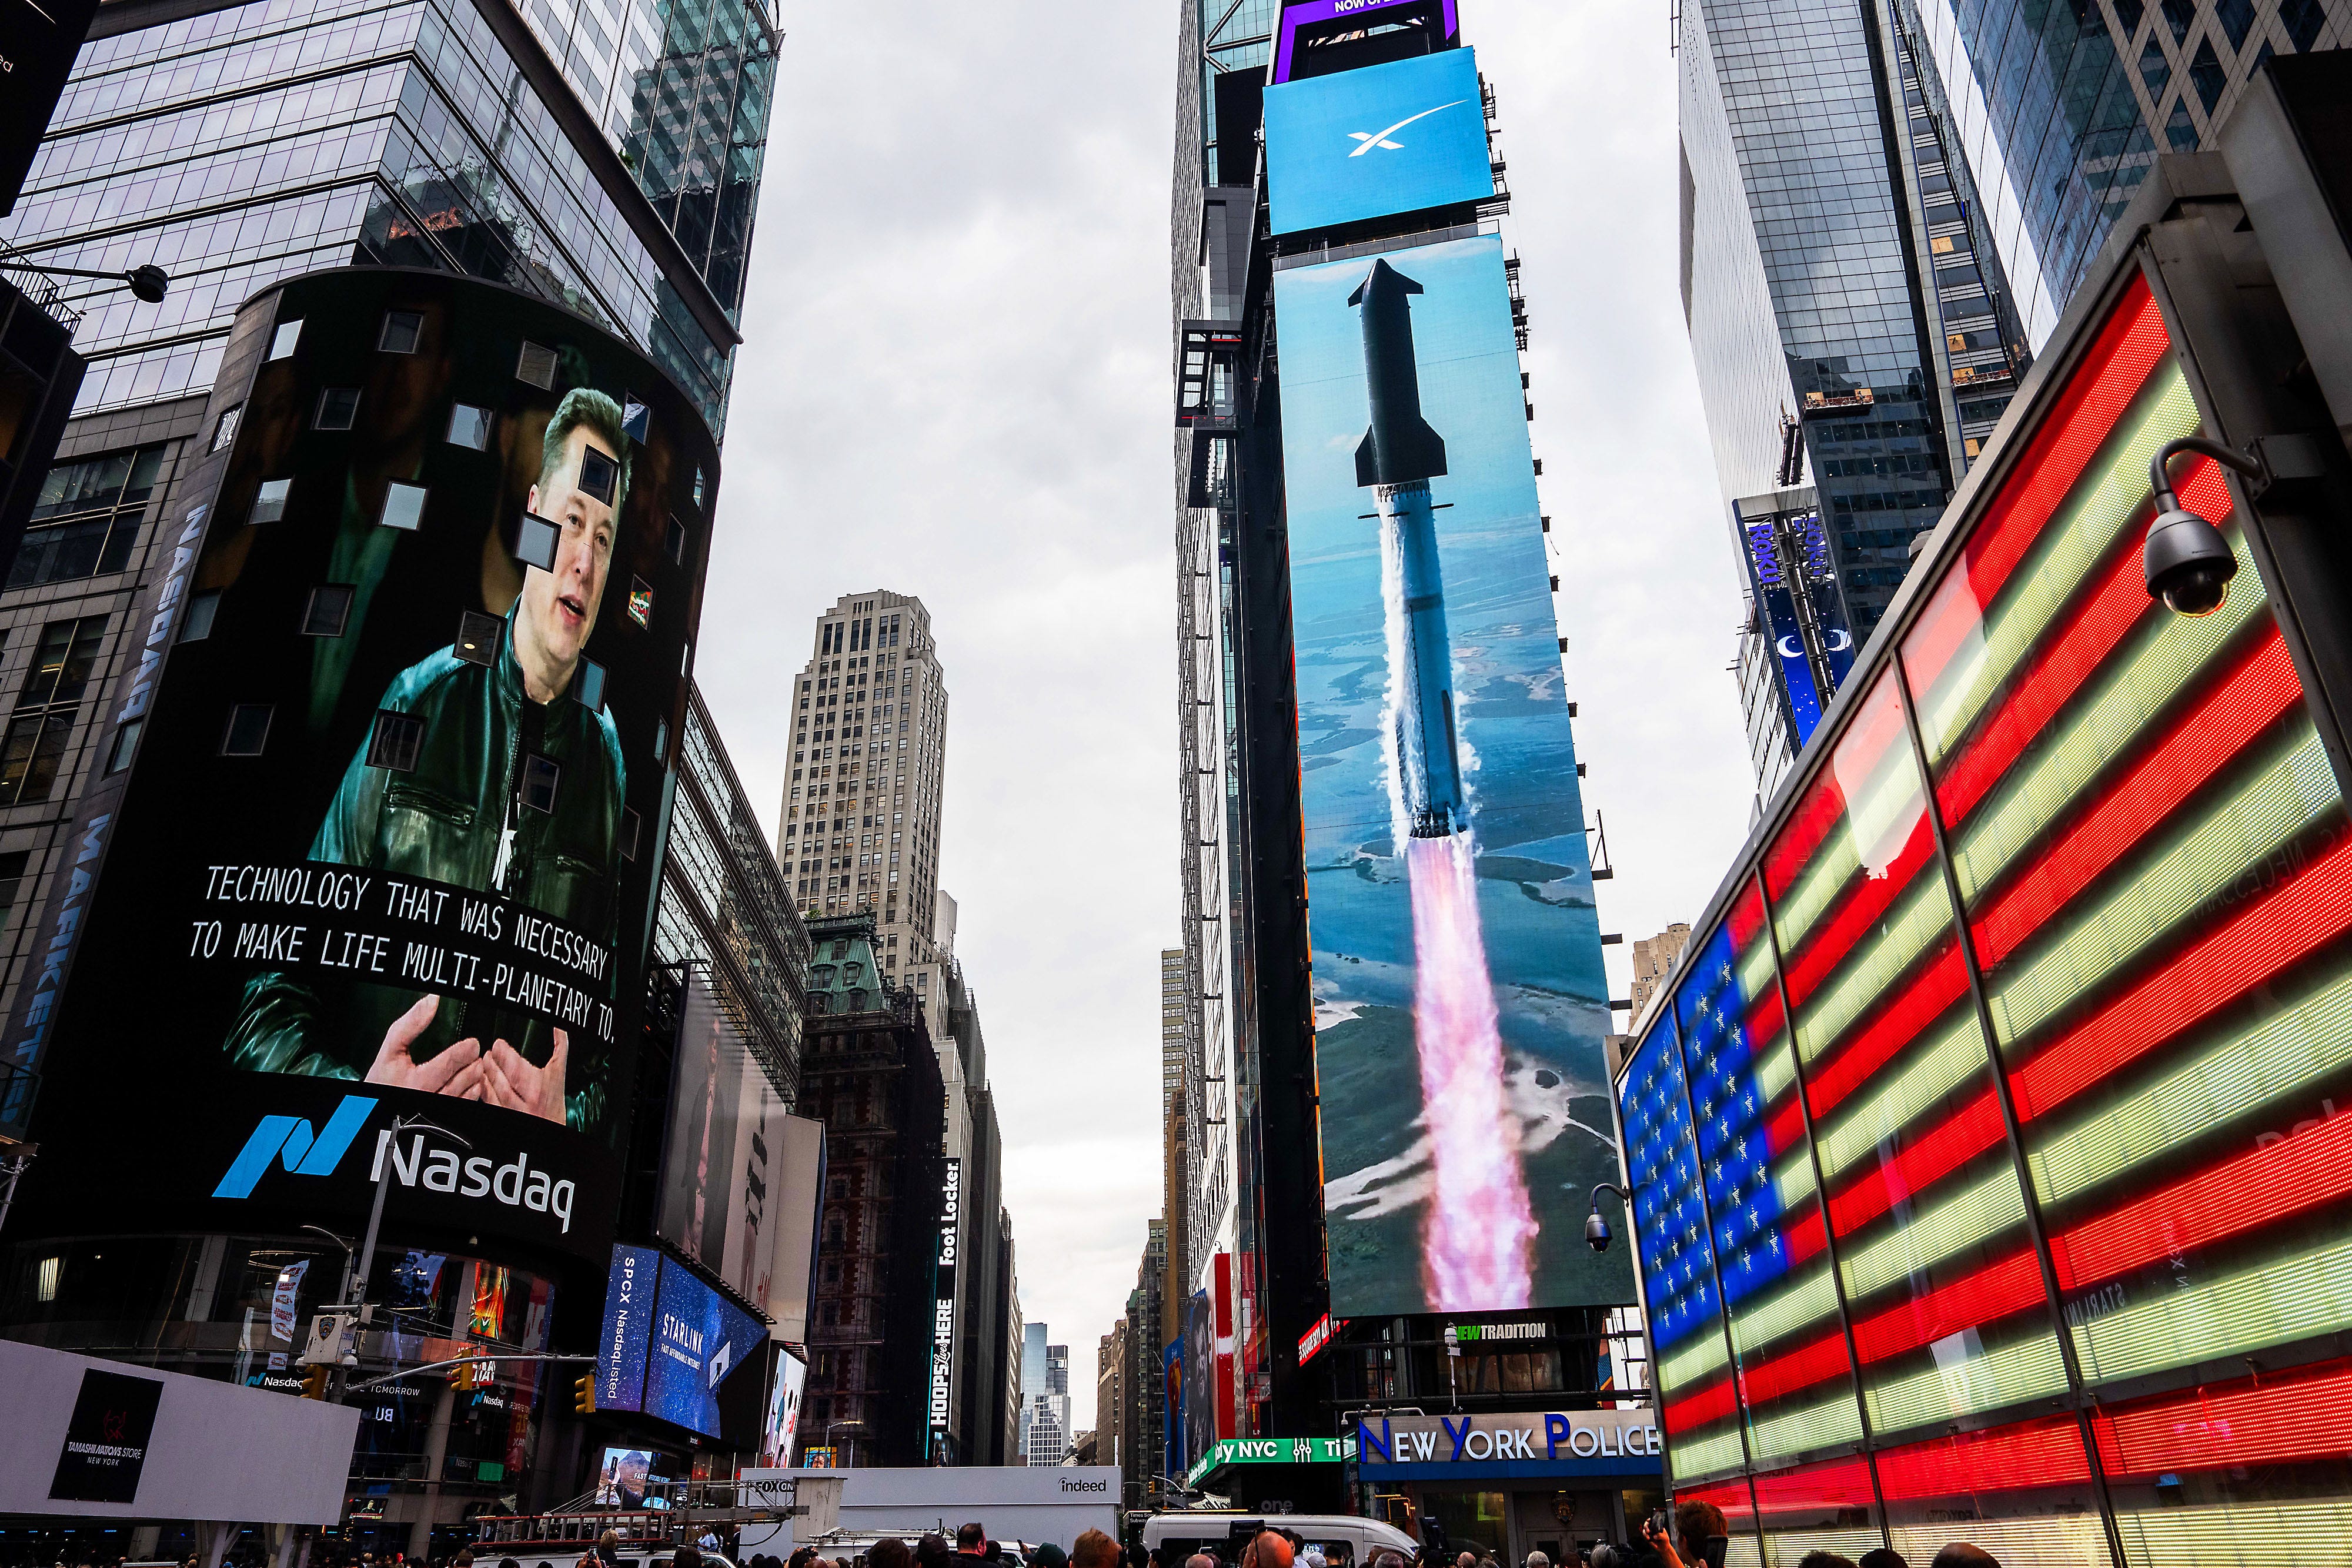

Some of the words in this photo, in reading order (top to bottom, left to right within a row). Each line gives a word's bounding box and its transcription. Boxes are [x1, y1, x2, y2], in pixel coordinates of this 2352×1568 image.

[1748, 523, 1780, 584] ROKU
[117, 503, 208, 724] NASDAQ
[205, 864, 370, 912] TECHNOLOGY
[386, 881, 449, 926] THAT
[460, 905, 504, 941] WAS
[514, 915, 607, 980] NECESSARY
[190, 921, 223, 958] TO
[234, 923, 306, 962] MAKE
[319, 931, 388, 972] LIFE
[401, 943, 592, 1028] MULTI-PLANETARY
[369, 1129, 575, 1233] Nasdaq
[939, 1226, 956, 1265] Foot
[620, 1257, 635, 1303] SPCX
[663, 1313, 703, 1355] STARLINK
[935, 1299, 953, 1345] HERE
[661, 1343, 670, 1355] FAST
[669, 1348, 688, 1364] AFFORDABLE
[687, 1357, 700, 1370] INTERNET
[934, 1342, 951, 1367] Lives
[371, 1385, 420, 1396] TOMORROW
[483, 1395, 503, 1409] Nasdaq
[931, 1364, 949, 1425] HOOPS
[68, 1442, 97, 1454] TAMASHII
[1239, 1441, 1277, 1457] NYC
[1359, 1419, 1436, 1463] NEW
[1441, 1416, 1536, 1462] YORK
[1544, 1413, 1660, 1460] POLICE
[102, 1458, 119, 1466] YORK
[634, 1472, 646, 1480] FAST
[756, 1481, 779, 1492] FOX
[780, 1482, 794, 1492] ON
[1058, 1477, 1106, 1492] indeed
[1261, 1500, 1293, 1512] one
